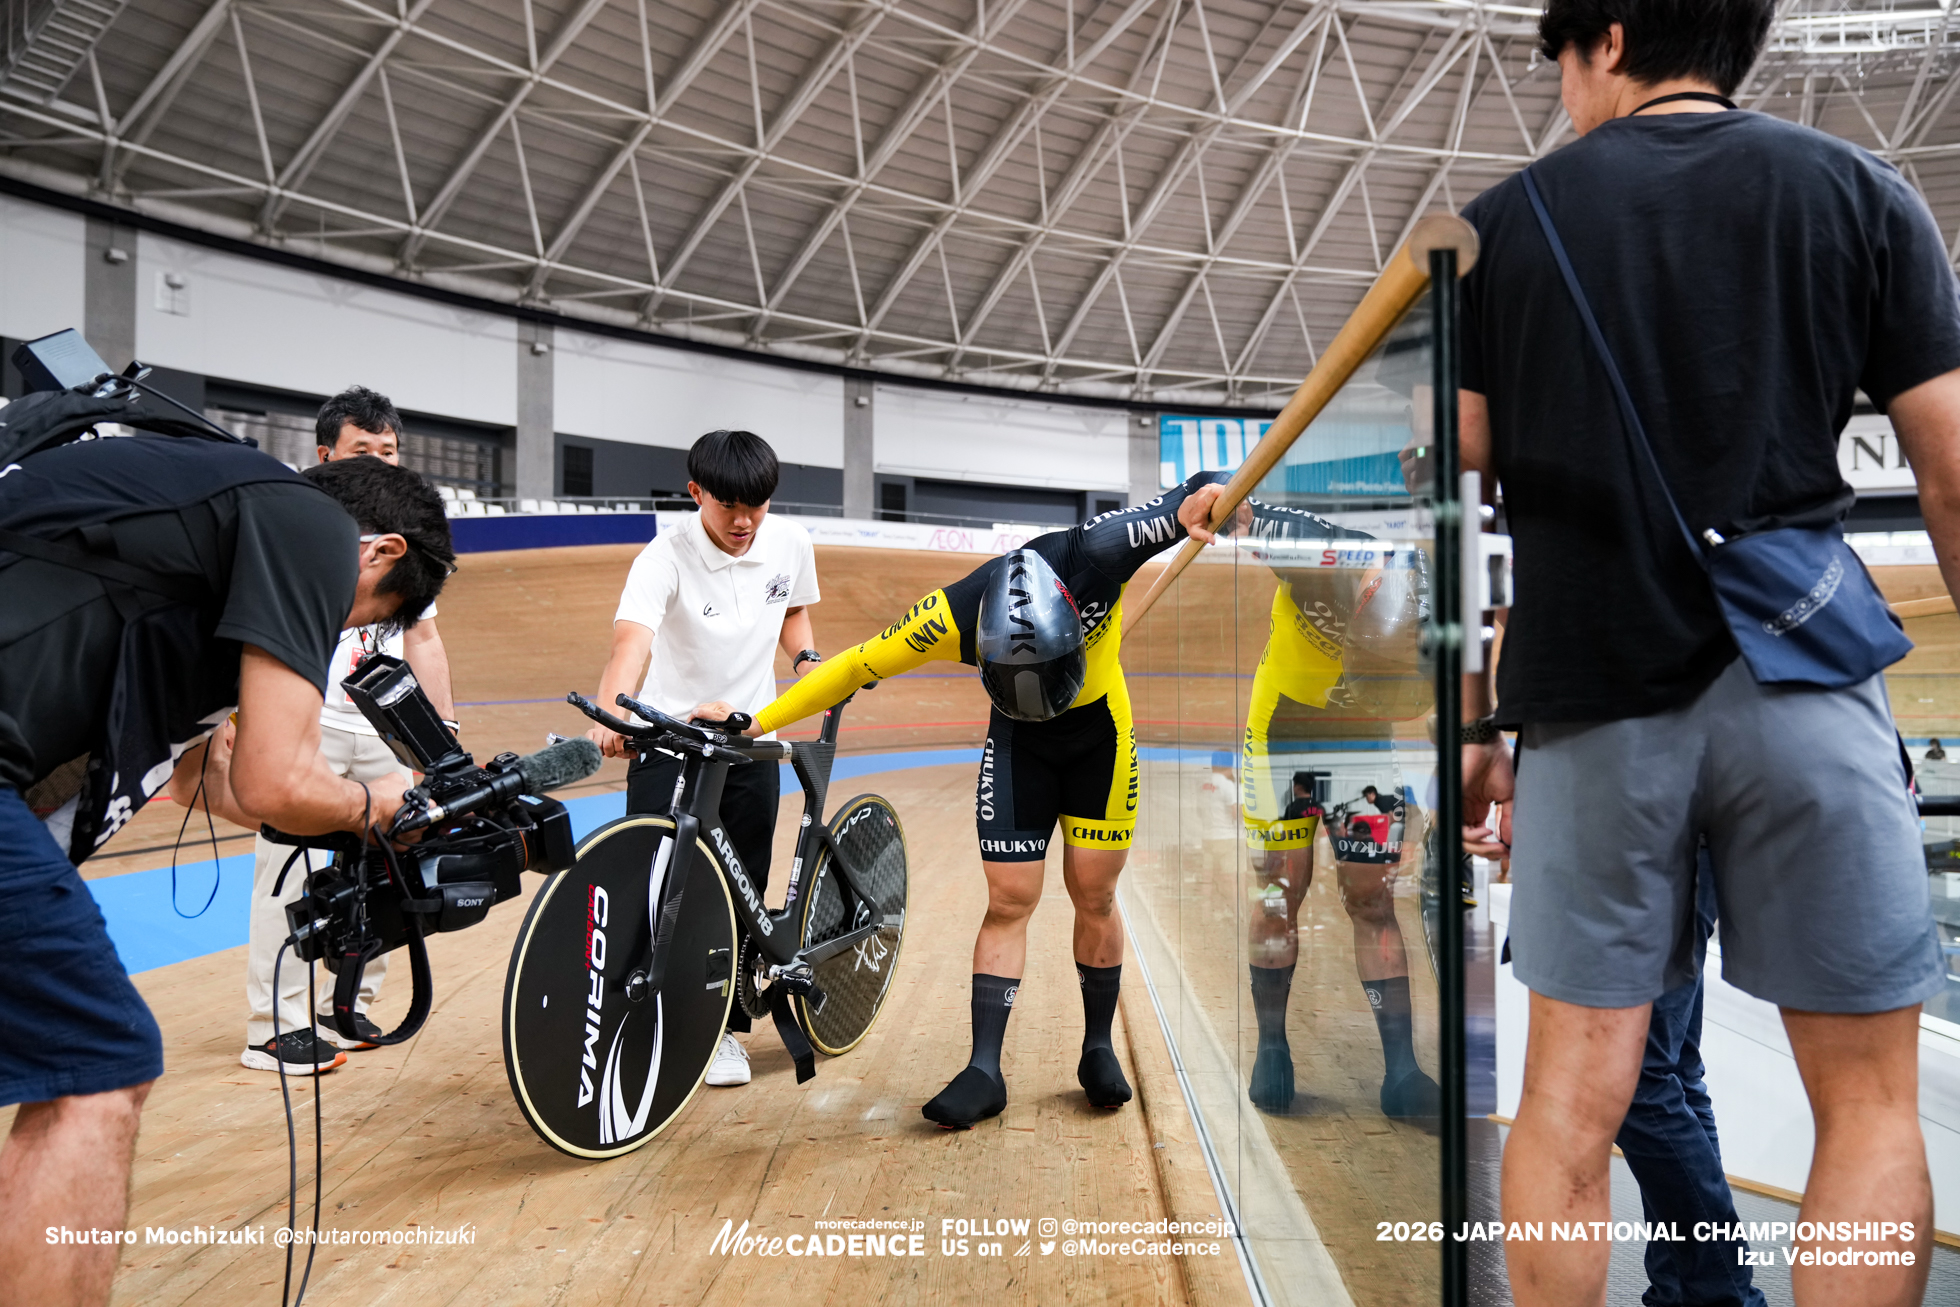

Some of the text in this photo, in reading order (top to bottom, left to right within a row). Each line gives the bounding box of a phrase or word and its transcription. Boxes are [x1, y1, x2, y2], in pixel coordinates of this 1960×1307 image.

[1126, 513, 1176, 548] UNIV
[1320, 549, 1375, 566] SPEED
[905, 613, 948, 653] UNIV
[980, 737, 995, 821] CHUKYO
[1126, 727, 1139, 812] CHUKYO
[980, 839, 1046, 853] CHUKYO
[457, 898, 485, 907] SONY
[710, 827, 774, 937] ARGON 18
[584, 884, 596, 971] CARBON+
[577, 886, 609, 1109] CORIMA
